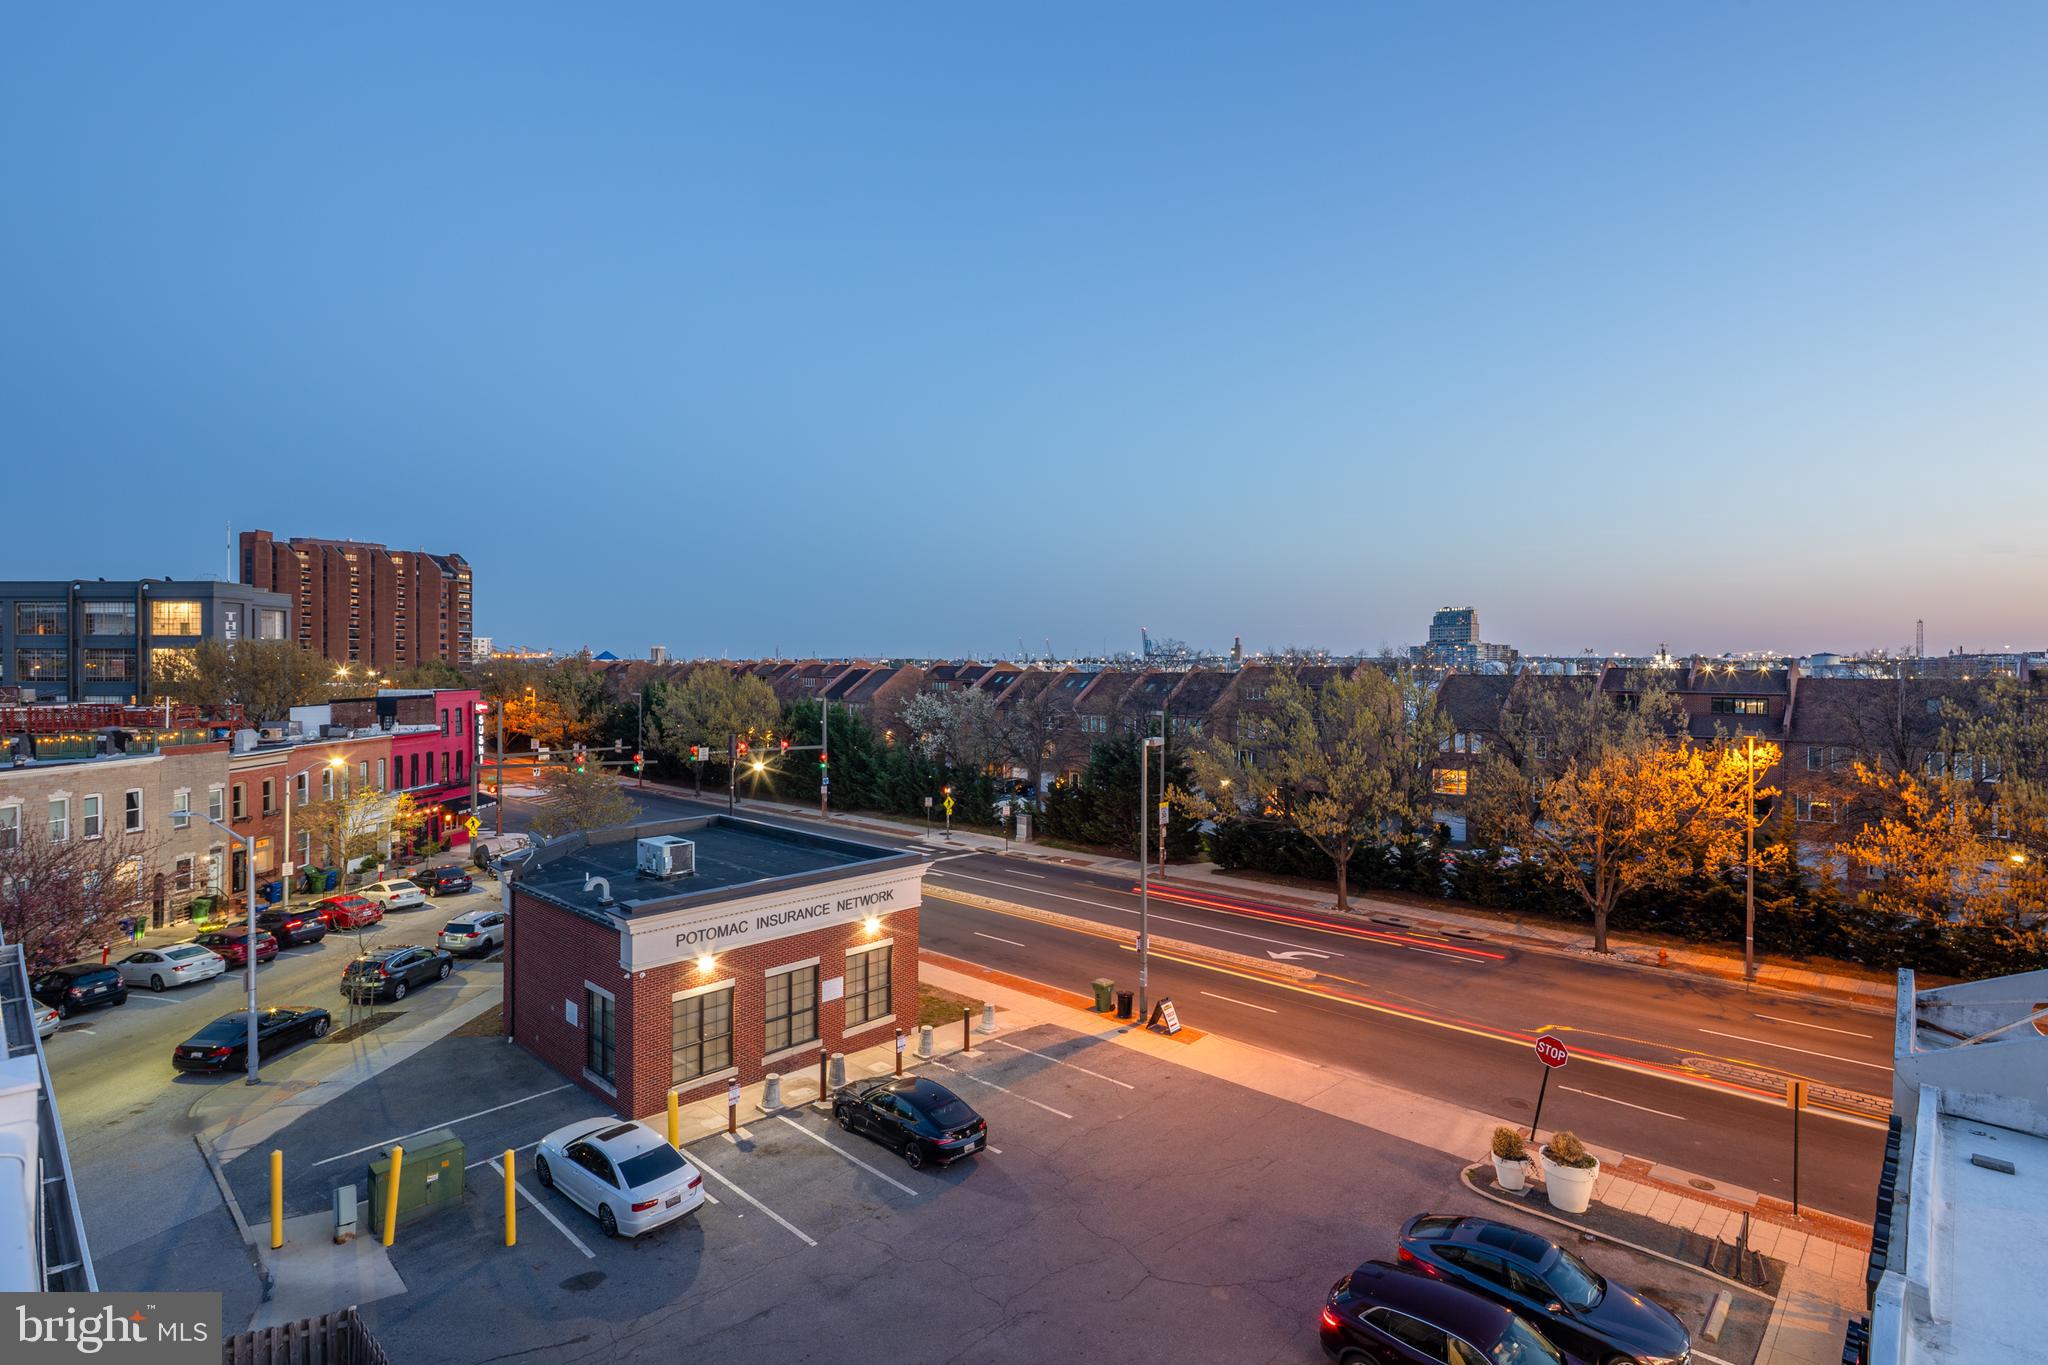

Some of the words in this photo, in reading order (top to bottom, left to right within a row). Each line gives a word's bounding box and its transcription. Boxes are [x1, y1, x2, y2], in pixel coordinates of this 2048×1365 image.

[225, 611, 237, 640] THE
[676, 920, 749, 947] POTOMAC
[756, 903, 831, 930] INSURANCE
[837, 889, 895, 912] NETWORK
[1537, 1041, 1566, 1061] STOP
